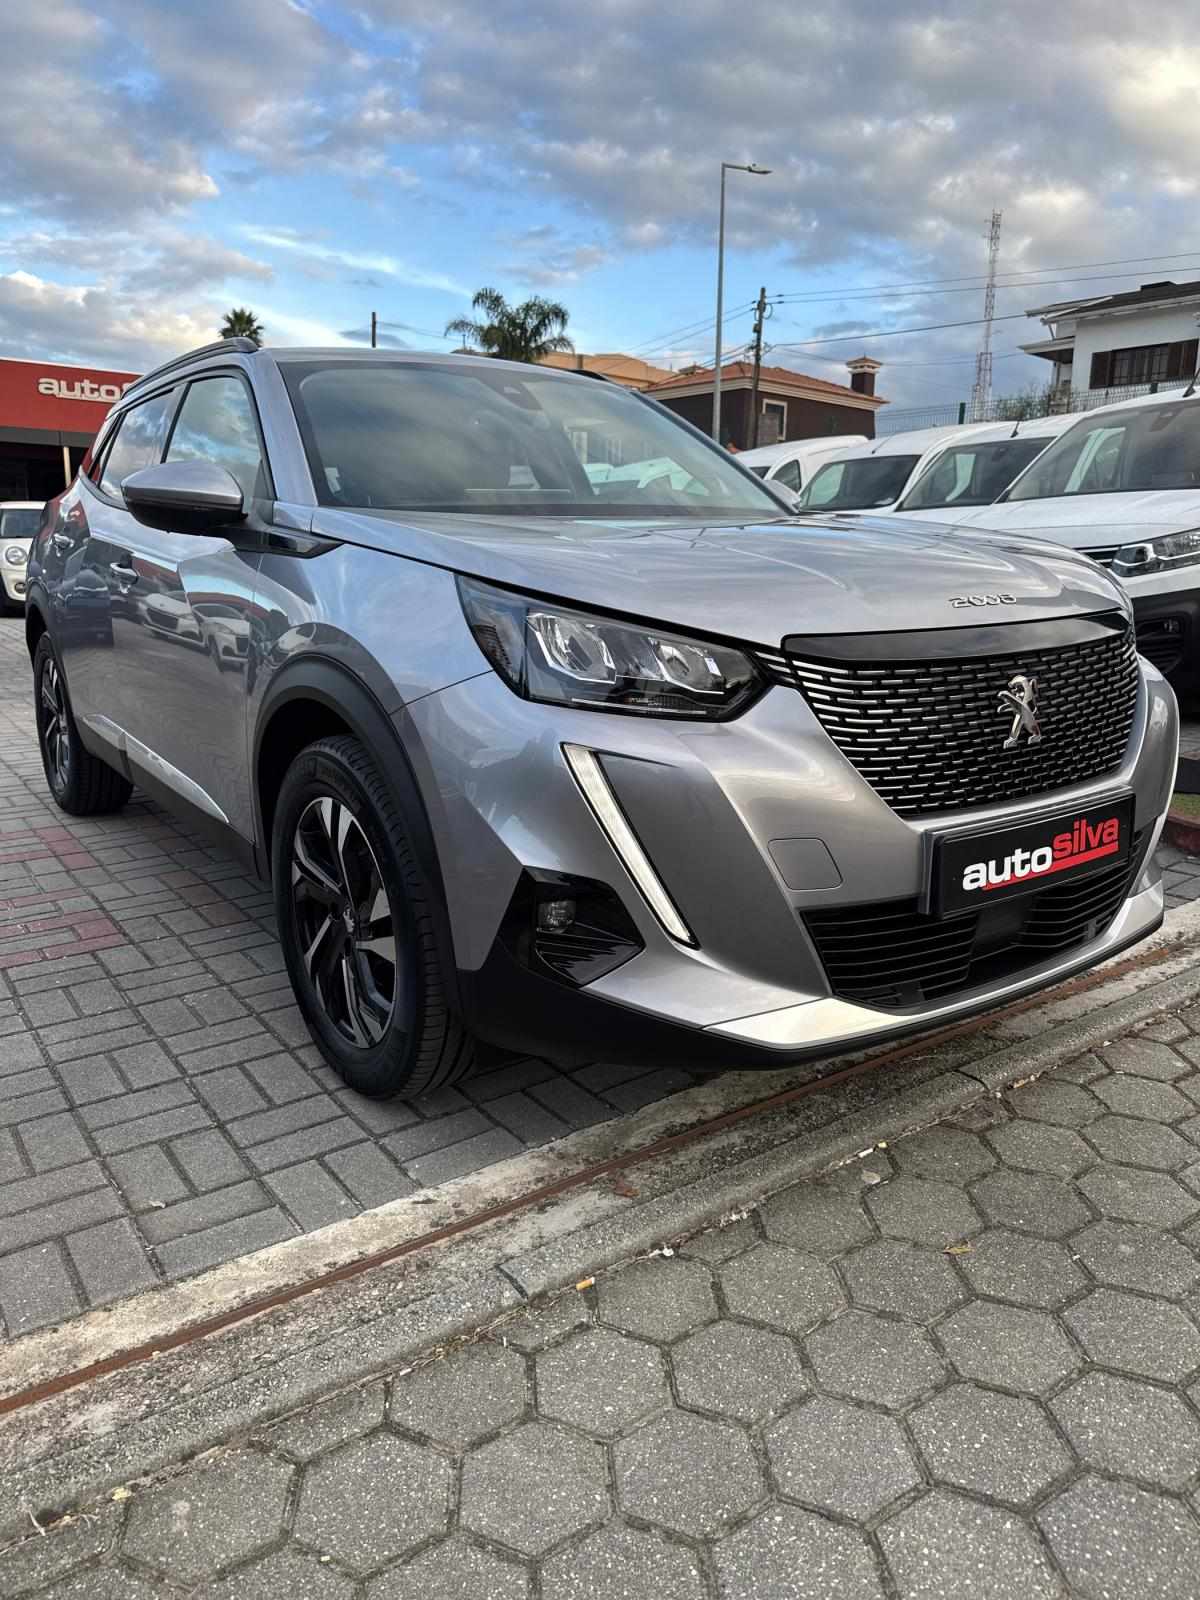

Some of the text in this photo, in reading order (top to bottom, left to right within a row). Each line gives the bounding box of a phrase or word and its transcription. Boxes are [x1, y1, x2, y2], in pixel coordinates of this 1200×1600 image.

[38, 378, 131, 402] auto
[948, 594, 1017, 608] 2008
[962, 817, 1120, 891] autosilva
